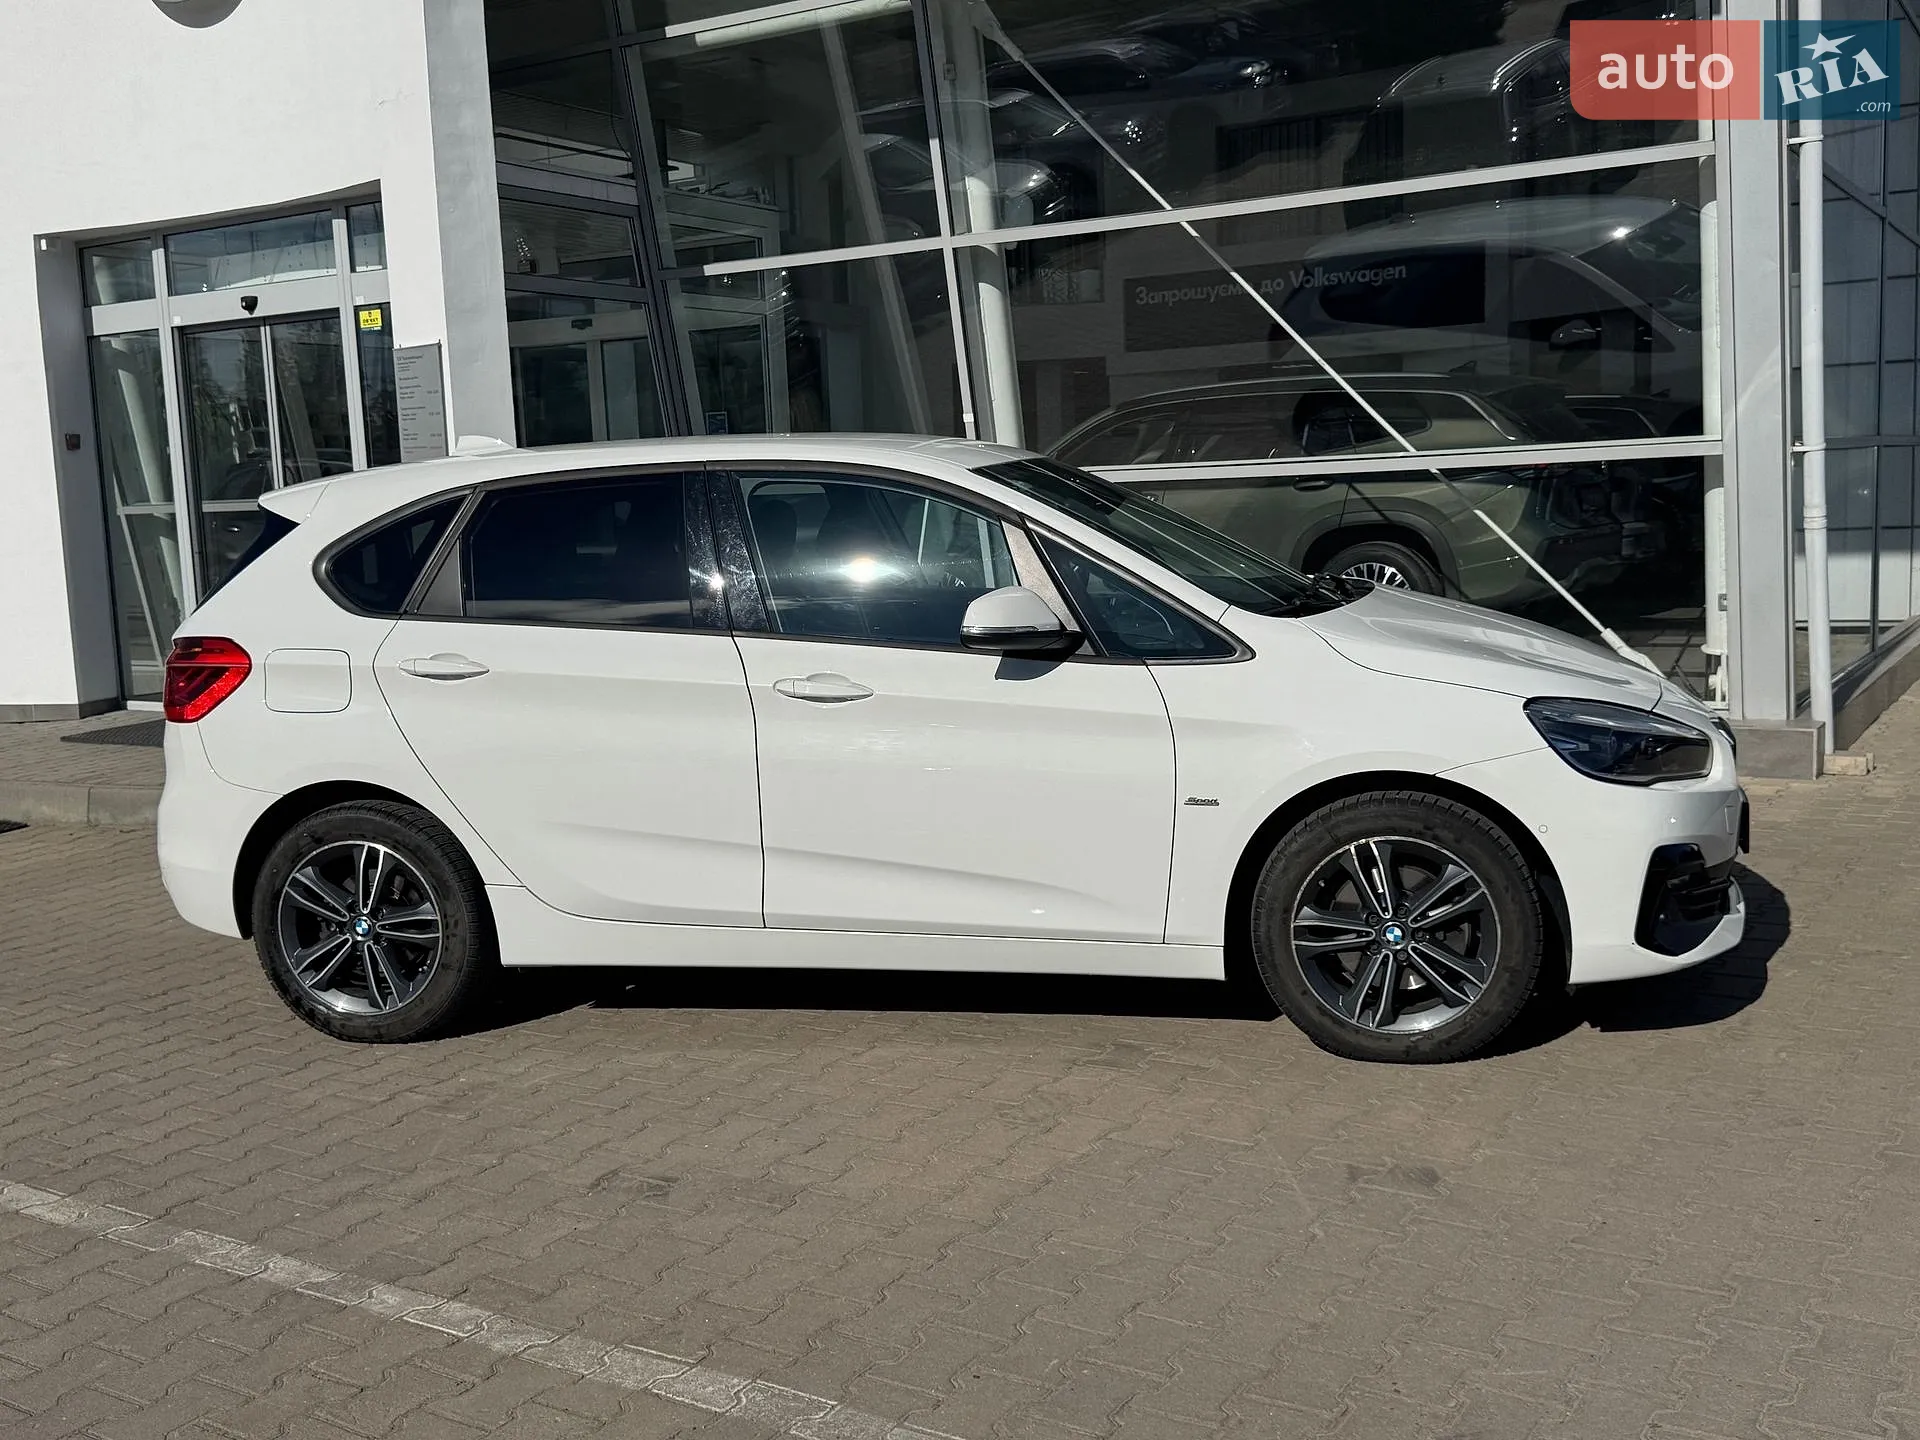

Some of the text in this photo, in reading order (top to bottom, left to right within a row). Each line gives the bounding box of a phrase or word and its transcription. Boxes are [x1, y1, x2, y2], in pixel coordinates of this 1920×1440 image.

[1135, 265, 1407, 307] Запрошуєм до Volkswagen
